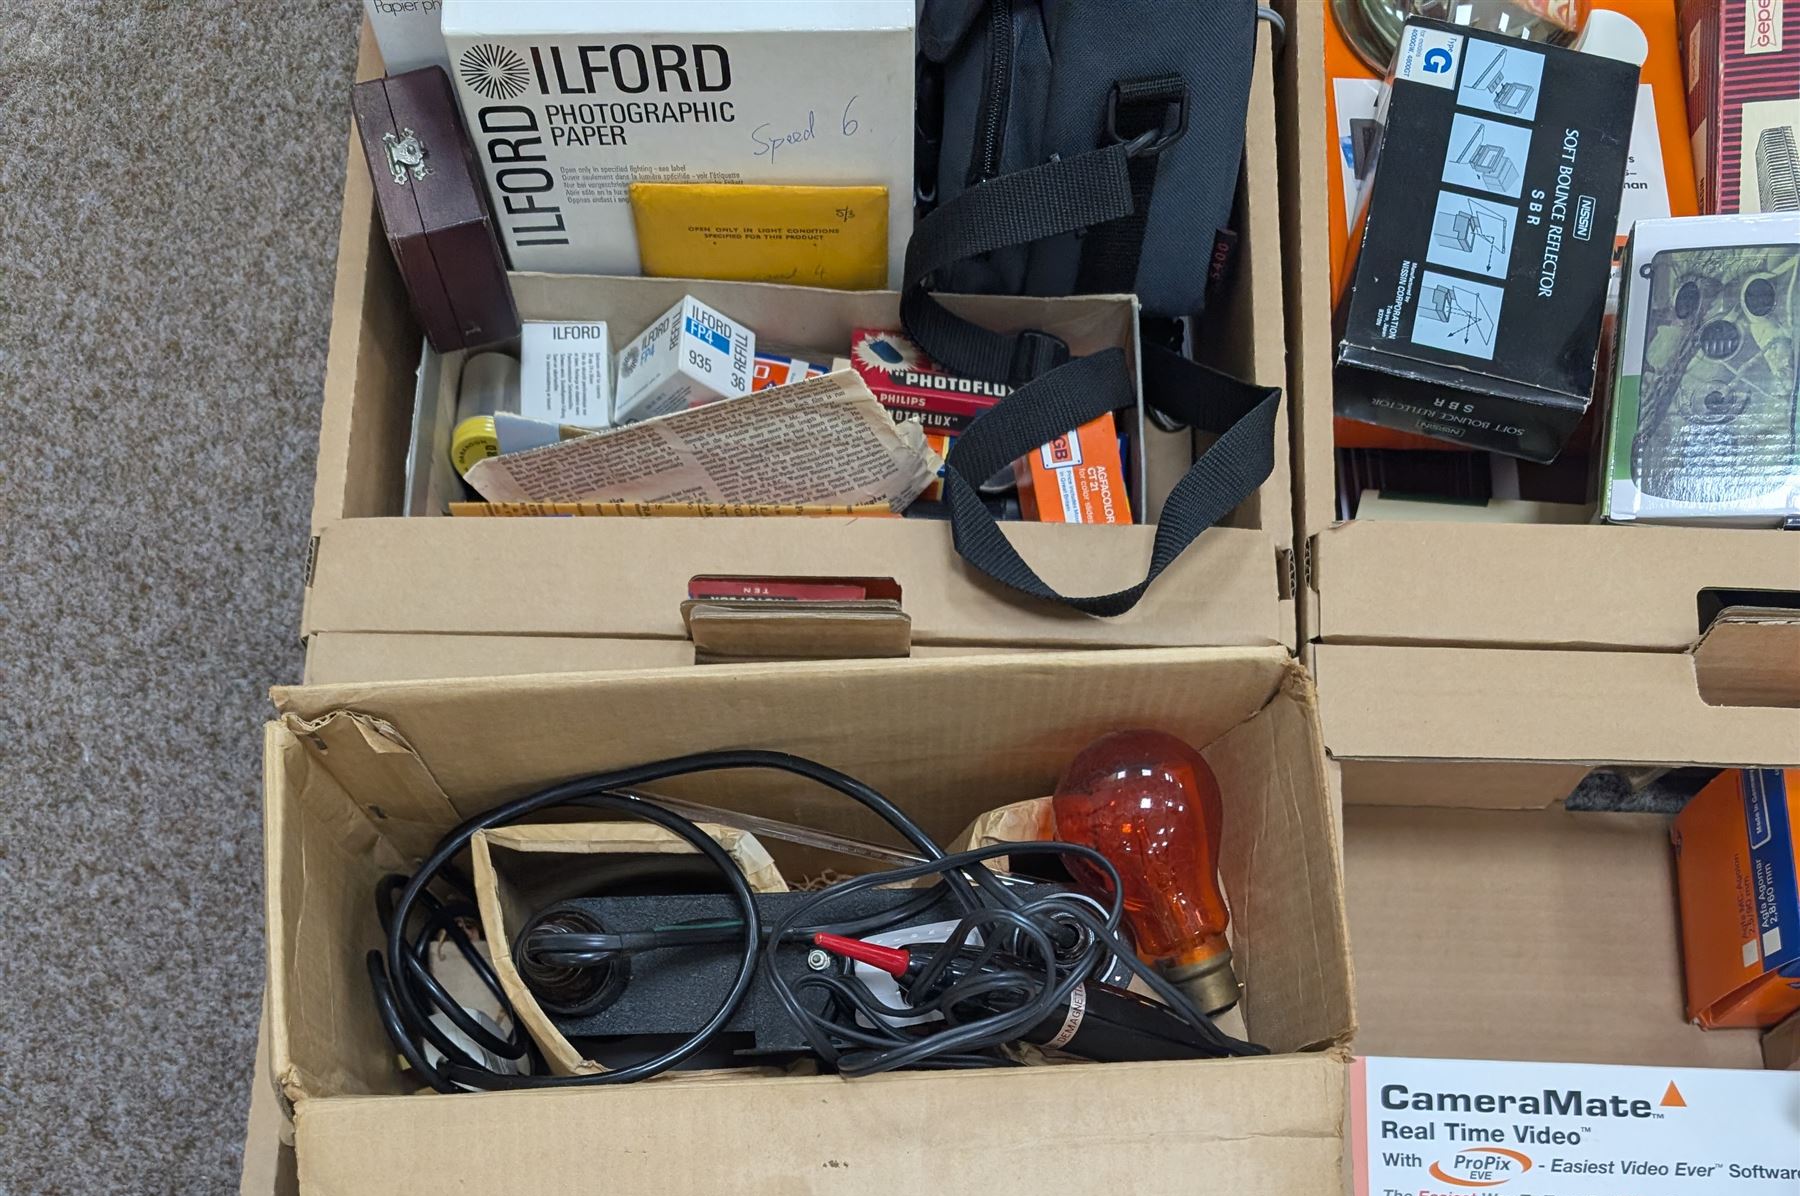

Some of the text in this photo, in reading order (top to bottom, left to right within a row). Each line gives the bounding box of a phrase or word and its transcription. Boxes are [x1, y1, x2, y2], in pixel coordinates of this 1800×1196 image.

[1448, 38, 1457, 52] Type
[530, 44, 732, 94] ILFORD
[1423, 48, 1452, 73] G
[545, 102, 736, 125] PHOTOGRAPHIC
[551, 125, 628, 146] PAPER
[752, 95, 858, 164] Speed 6
[478, 105, 569, 246] ILFORD
[1538, 129, 1579, 297] SOFT BOUNCE REFLECTOR
[1577, 199, 1591, 236] NISSIN
[1388, 260, 1410, 340] NISSIN CORPORATION
[554, 326, 600, 340] ILFORD
[691, 321, 713, 345] FP4
[692, 305, 732, 339] ILFORD
[689, 350, 712, 373] 935
[731, 333, 748, 392] 36 REFILL
[880, 393, 926, 407] PHILIPS
[1440, 410, 1490, 429] BOUNCE
[1053, 438, 1067, 459] GB
[1088, 467, 1097, 480] CT
[1081, 479, 1089, 500] color
[1097, 466, 1115, 523] AGFACOLOR
[743, 587, 769, 595] TEN
[1764, 863, 1774, 884] mm
[1755, 860, 1770, 928] Agfa Agomar
[1381, 1120, 1435, 1140] Real
[1444, 1123, 1505, 1143] Time
[1382, 1152, 1511, 1171] With ProPix
[1550, 1158, 1615, 1174] Easiest
[1620, 1160, 1669, 1176] Video
[1469, 1171, 1492, 1180] EVE
